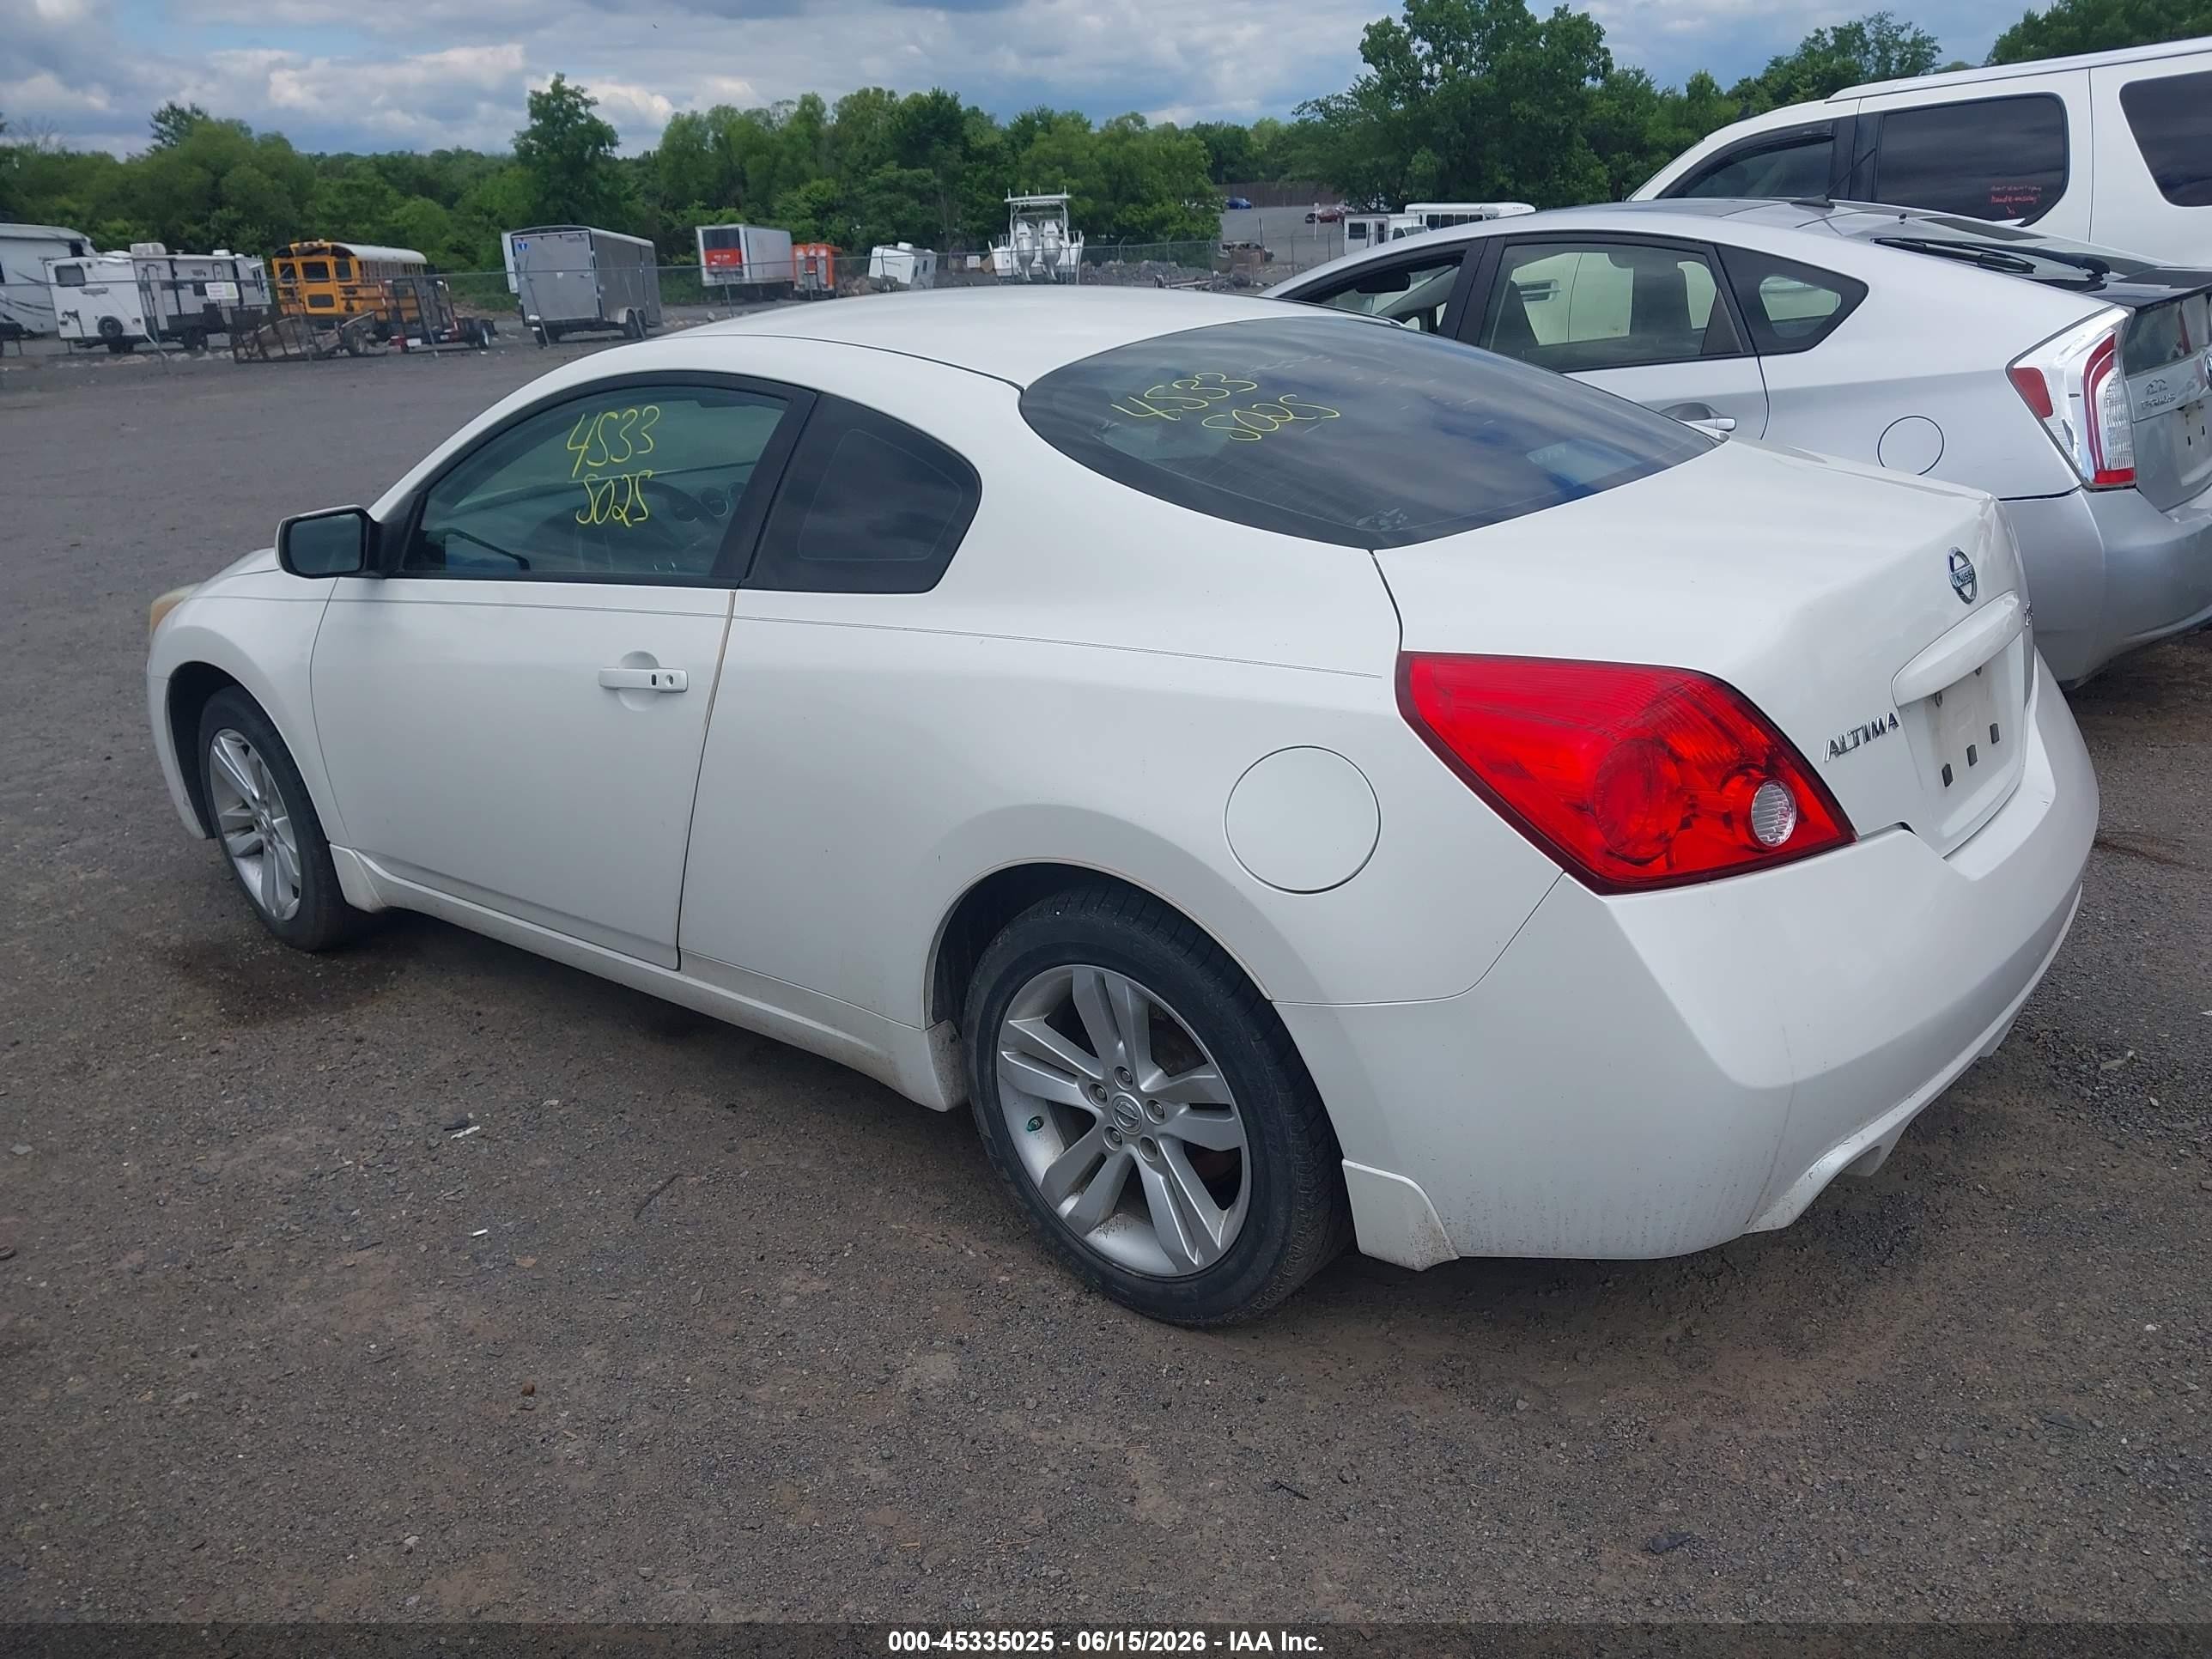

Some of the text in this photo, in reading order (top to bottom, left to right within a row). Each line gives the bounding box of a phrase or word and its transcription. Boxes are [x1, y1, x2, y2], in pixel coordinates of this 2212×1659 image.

[1110, 372, 1258, 421] 4533
[1201, 393, 1340, 441] 5025
[567, 404, 660, 478] 4533
[575, 469, 653, 527] 5025
[1824, 711, 1899, 763] ALTIMA
